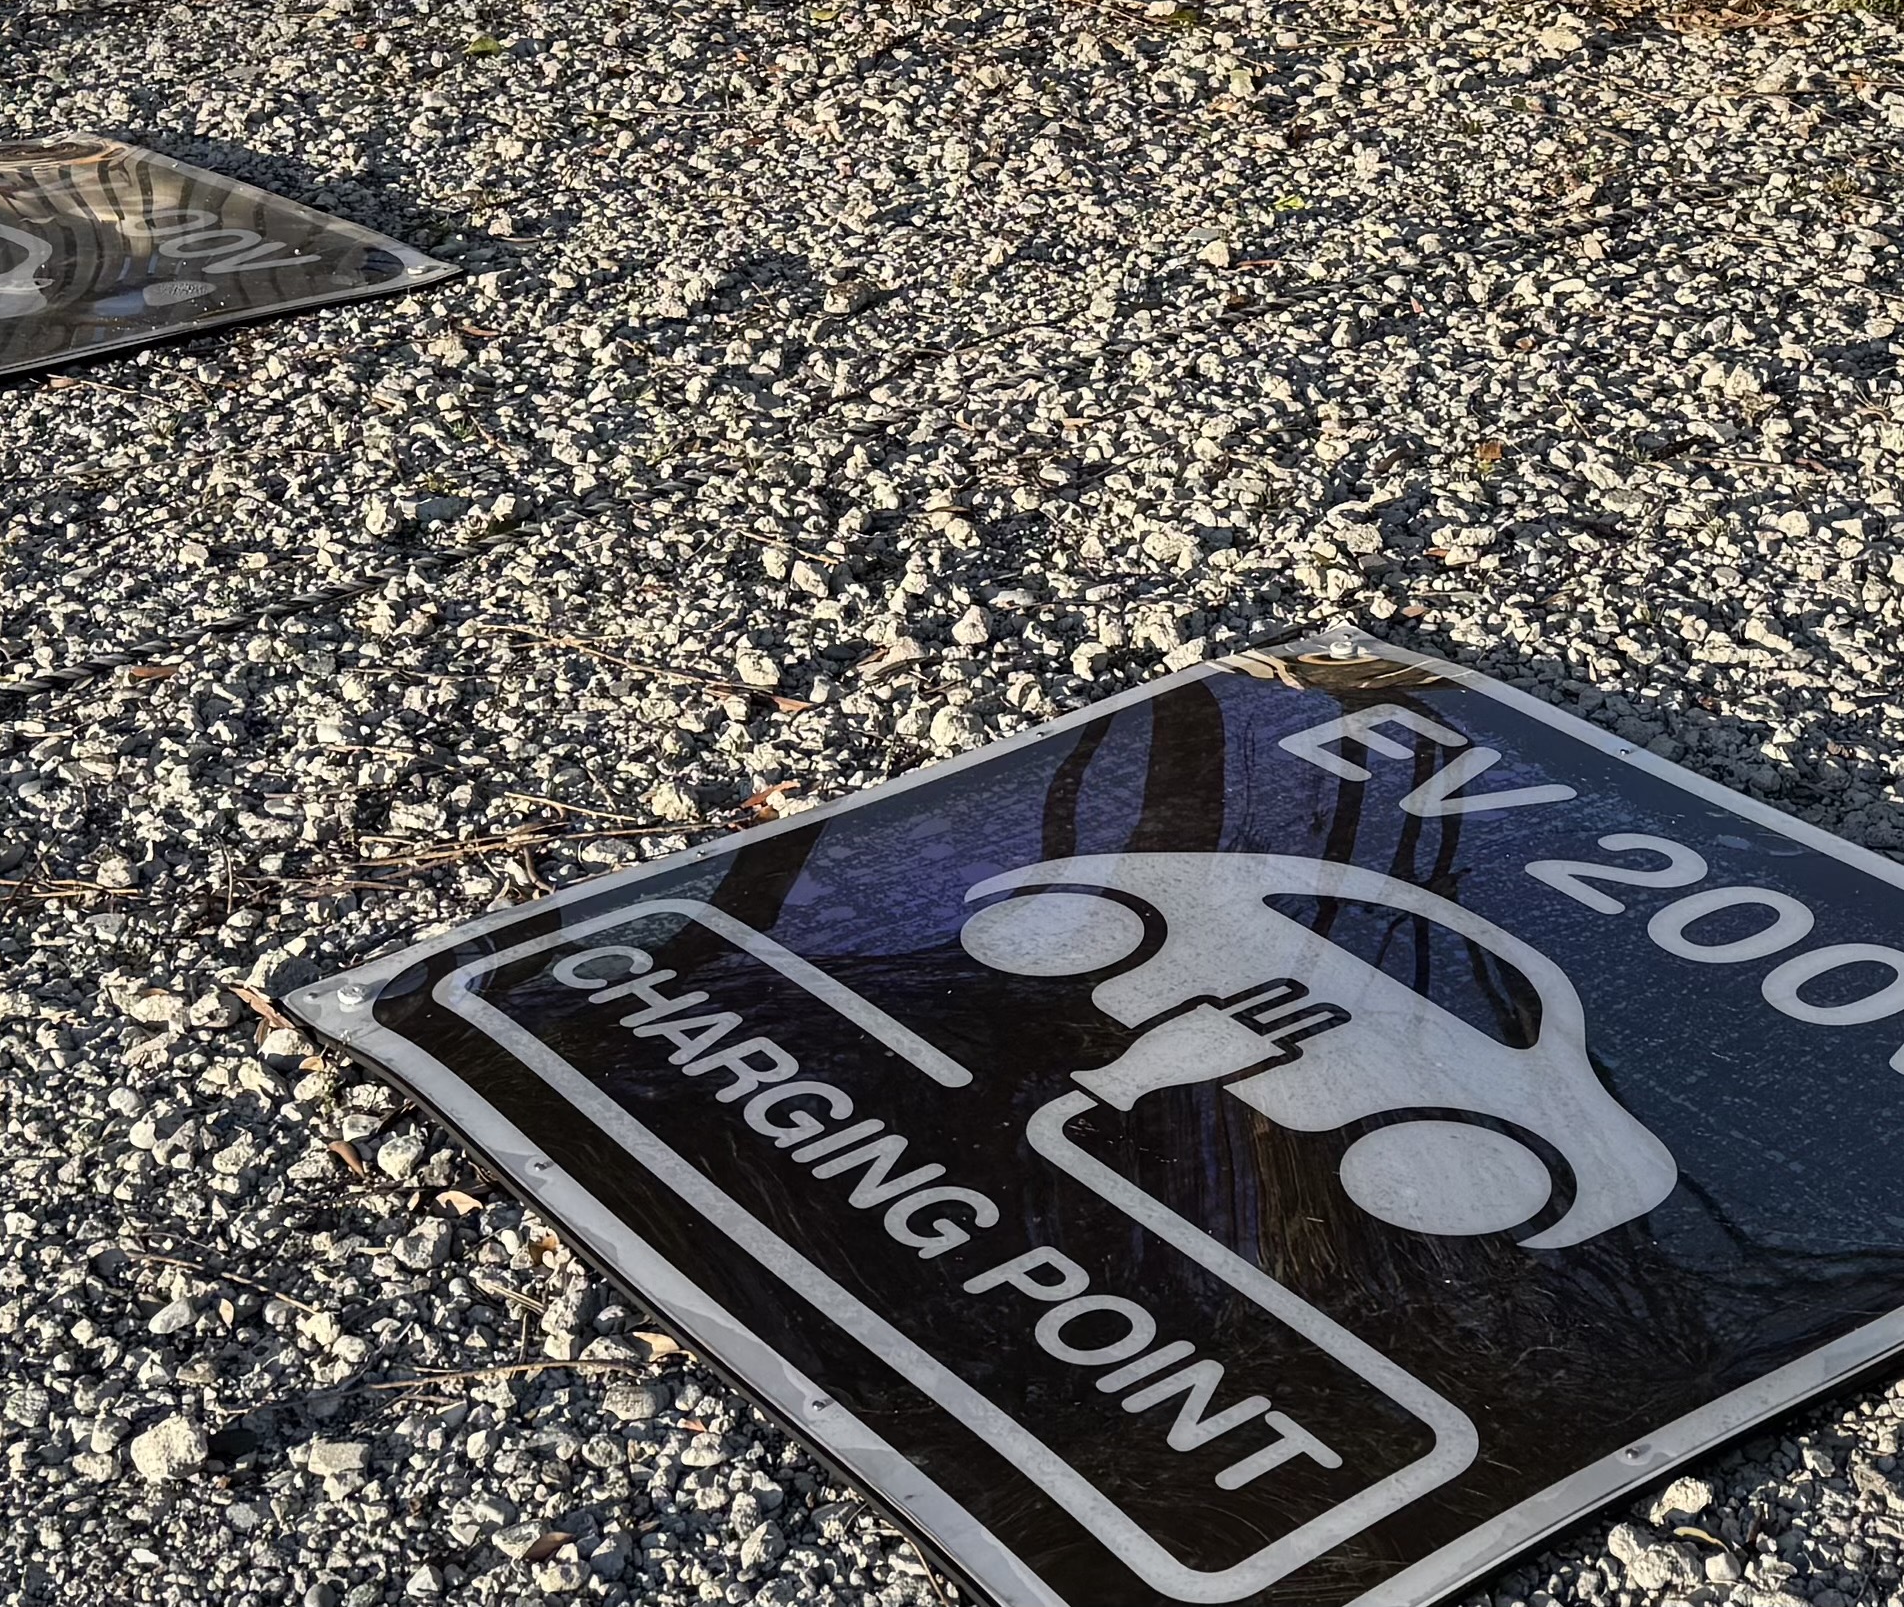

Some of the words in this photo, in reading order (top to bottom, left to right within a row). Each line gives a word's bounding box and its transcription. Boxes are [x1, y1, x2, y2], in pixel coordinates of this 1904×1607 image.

[1278, 702, 1577, 819] EV
[553, 943, 1001, 1262] CHARGING
[966, 1244, 1343, 1492] POINT
